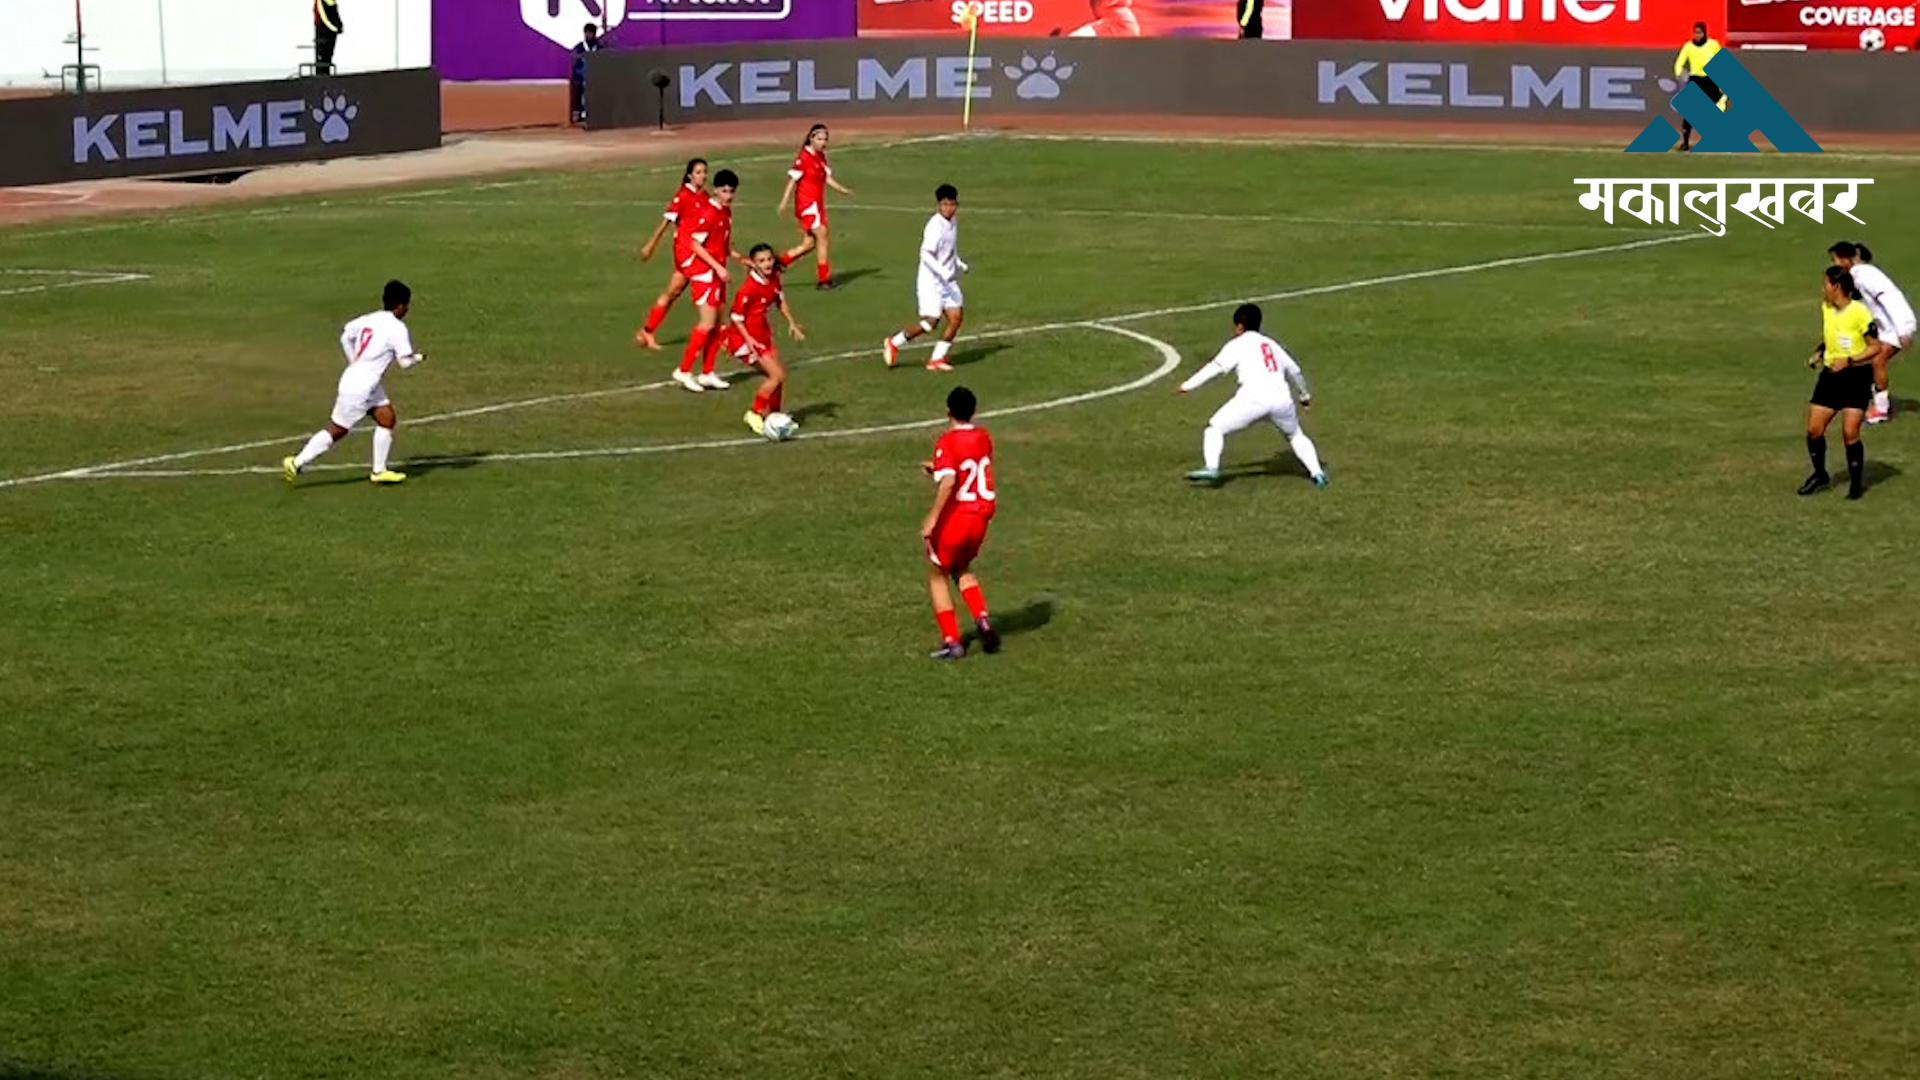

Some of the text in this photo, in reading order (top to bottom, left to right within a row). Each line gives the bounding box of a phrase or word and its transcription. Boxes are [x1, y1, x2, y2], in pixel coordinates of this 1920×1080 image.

[951, 0, 1034, 24] SPEED
[1799, 6, 1916, 27] COVERAGE
[679, 56, 993, 108] KELME
[1317, 60, 1647, 111] KELME
[72, 100, 307, 164] KELME
[956, 455, 996, 502] 20
